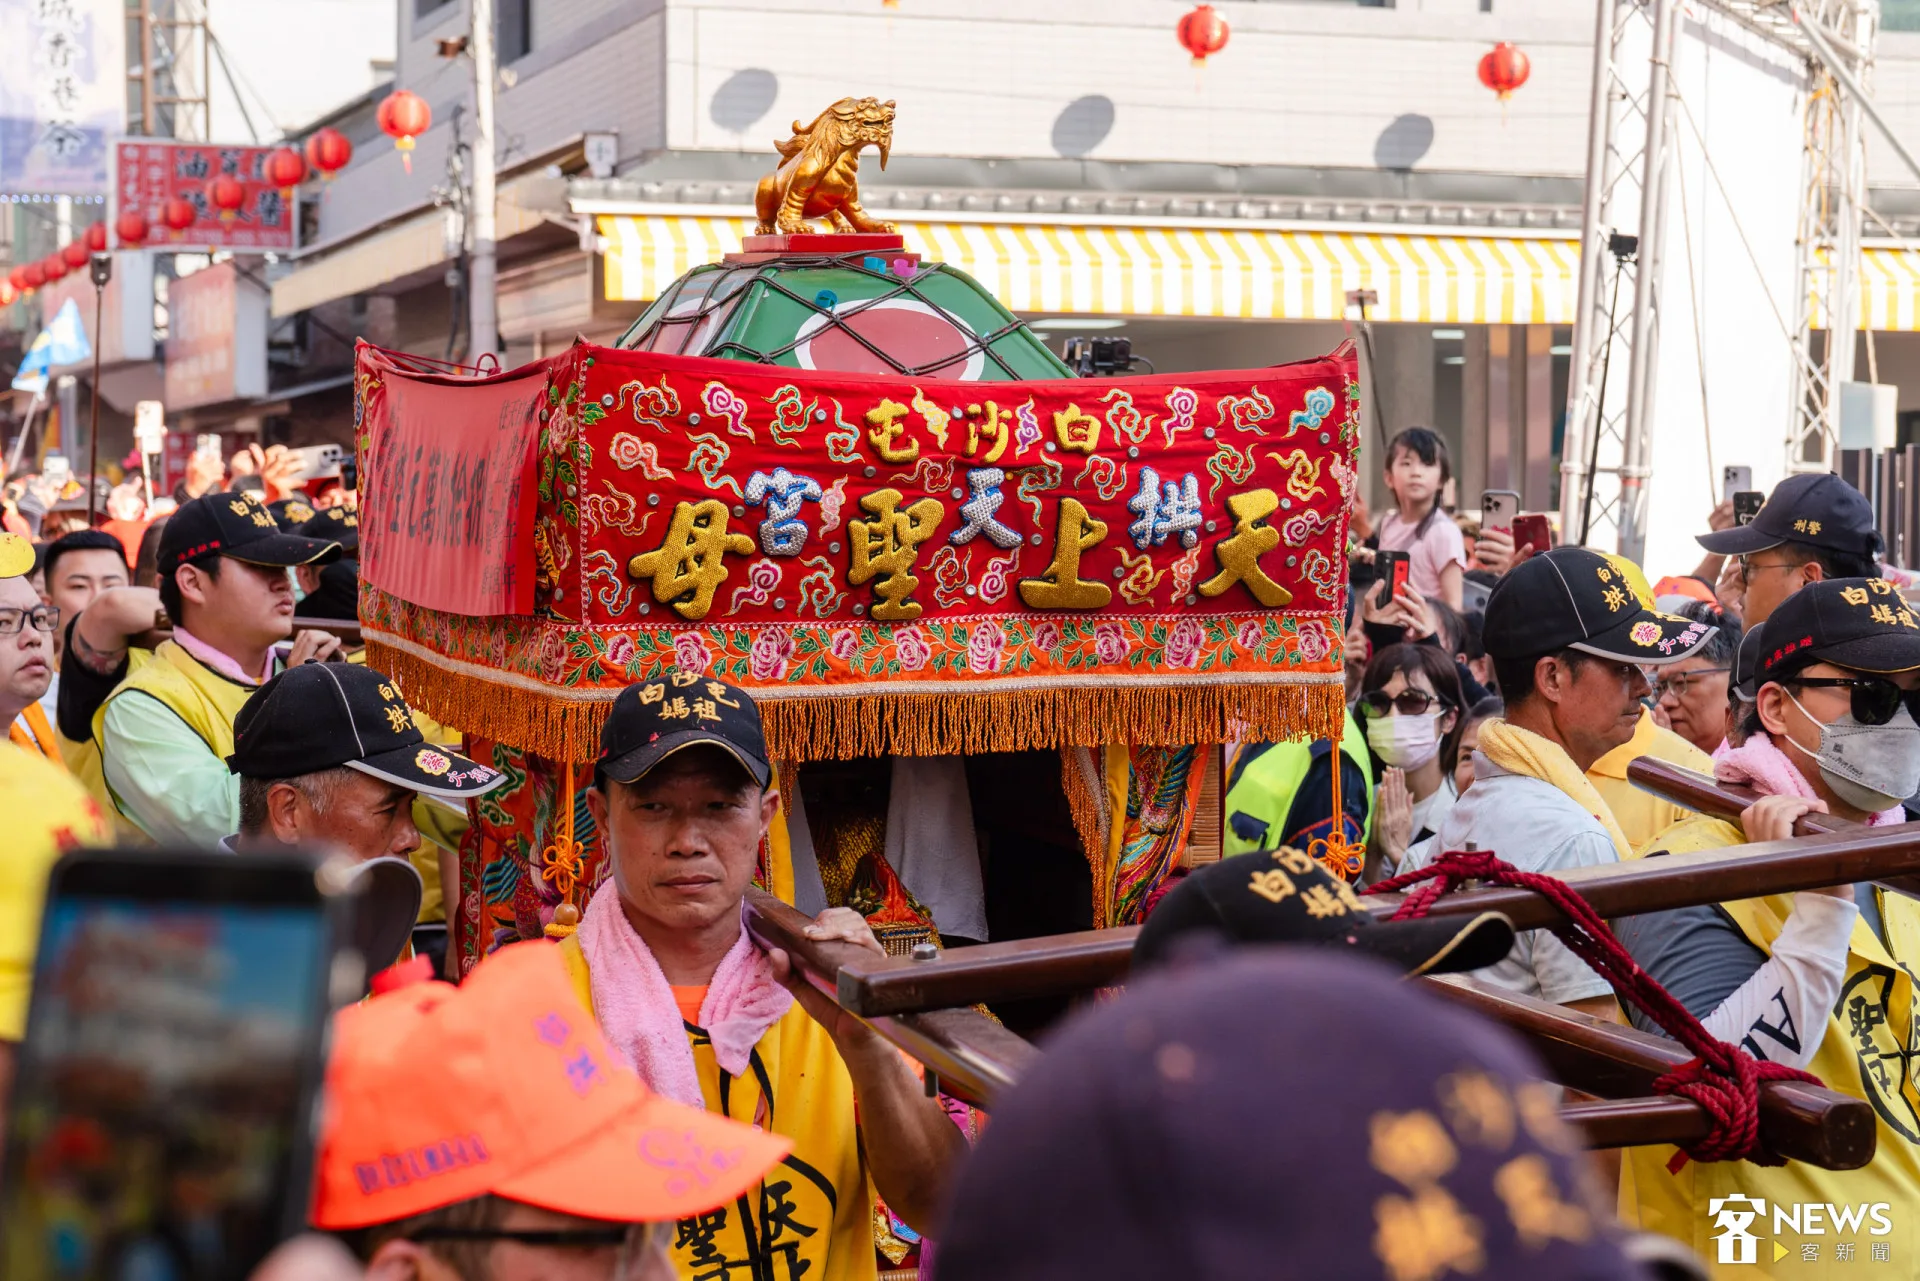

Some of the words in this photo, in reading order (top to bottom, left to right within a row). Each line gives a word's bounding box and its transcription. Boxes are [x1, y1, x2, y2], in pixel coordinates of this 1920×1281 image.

[866, 397, 1102, 464] 白沙屯
[744, 465, 1203, 556] 拱天宮
[628, 488, 1293, 621] 天上聖母
[638, 670, 741, 709] 白沙屯
[658, 696, 722, 722] 媽祖
